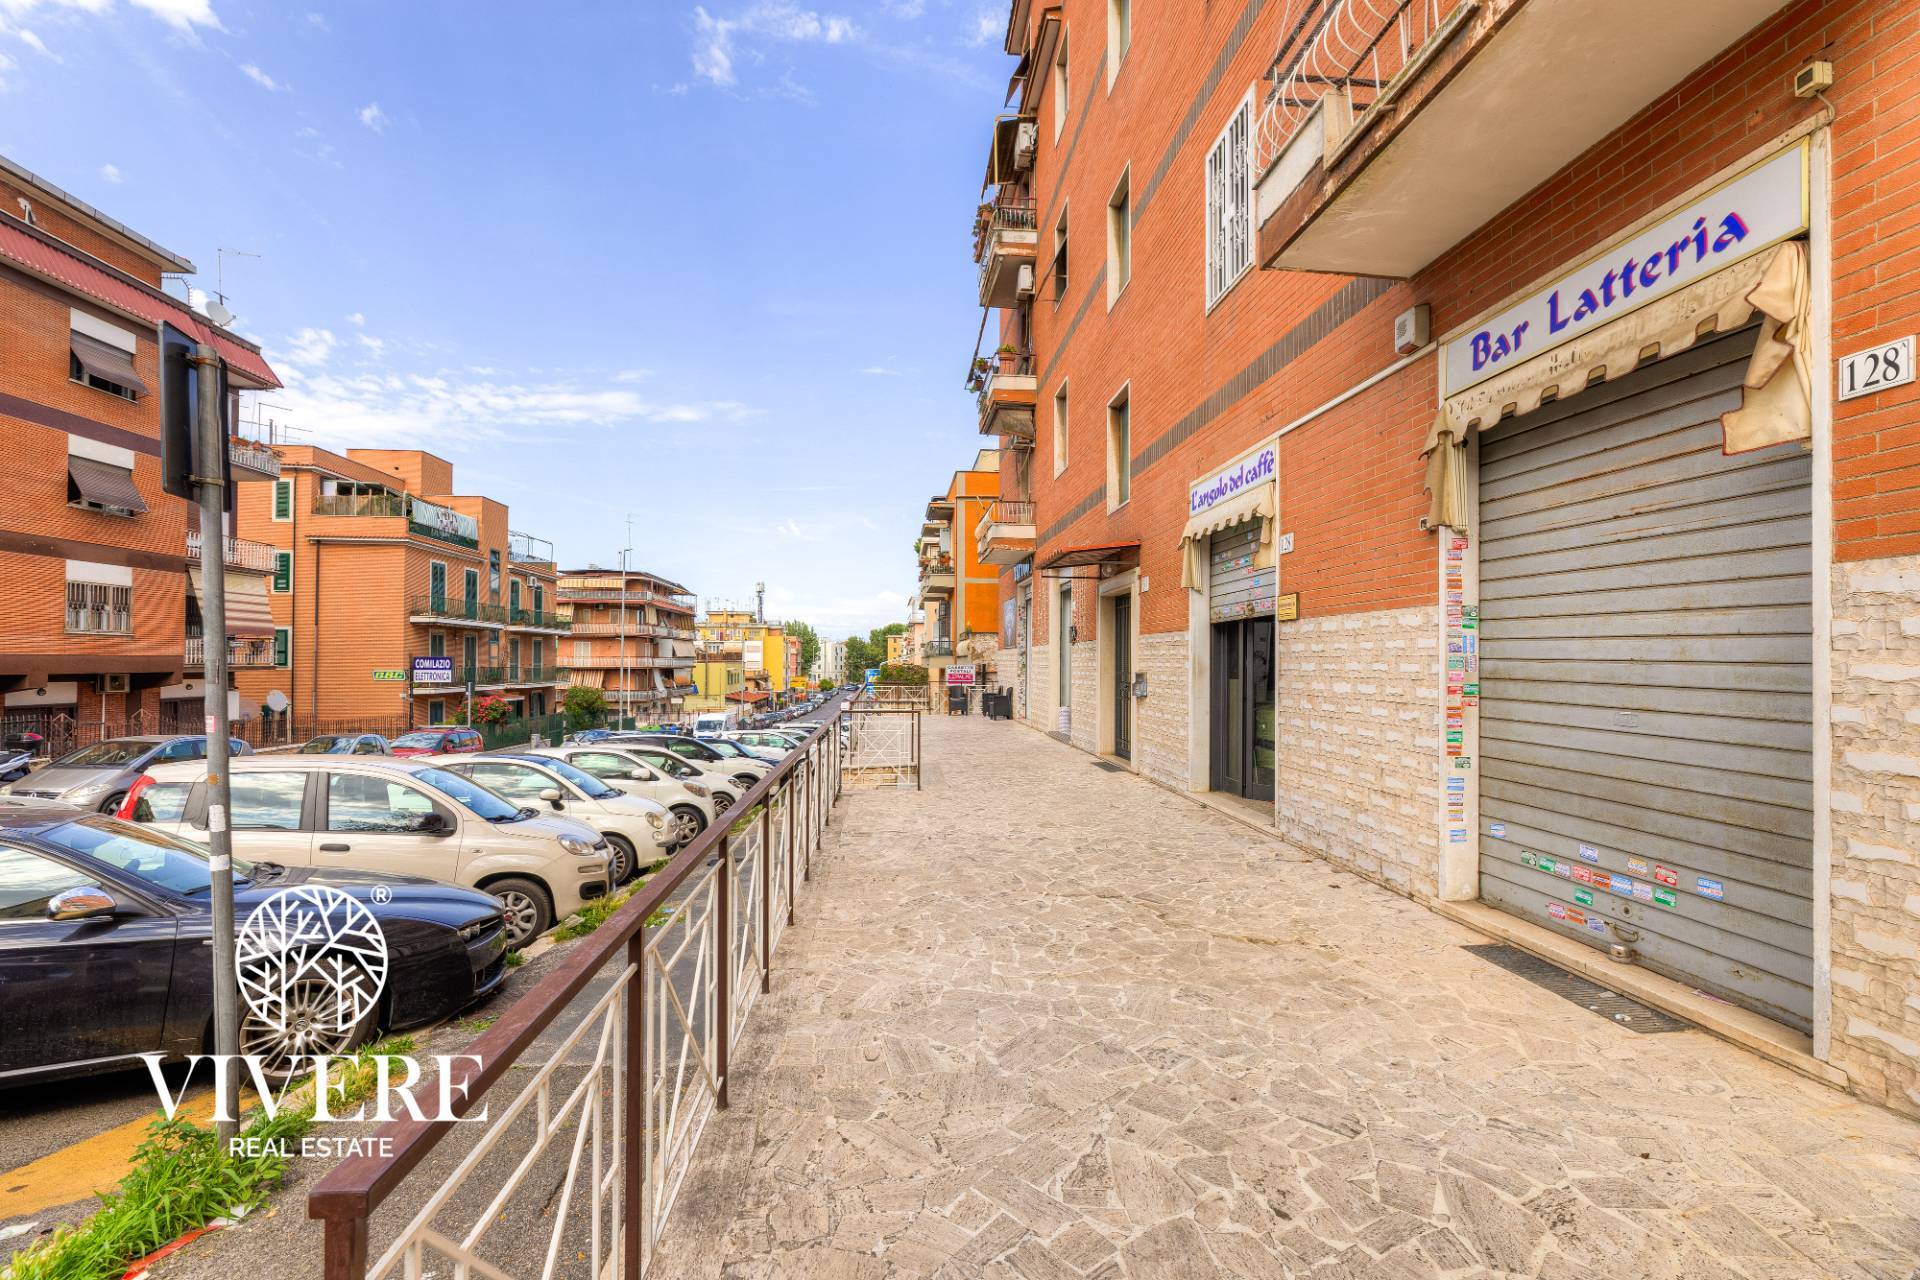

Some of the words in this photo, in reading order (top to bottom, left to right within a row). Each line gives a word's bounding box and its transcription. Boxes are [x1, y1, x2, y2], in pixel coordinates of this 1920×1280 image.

[1470, 320, 1530, 372] Bar
[1547, 211, 1751, 336] Latteria
[1191, 475, 1228, 511] L'angolo
[1229, 464, 1244, 493] del
[1245, 449, 1275, 484] caffè
[415, 659, 451, 668] COMILAZIO
[415, 672, 450, 681] ELETTRONICA
